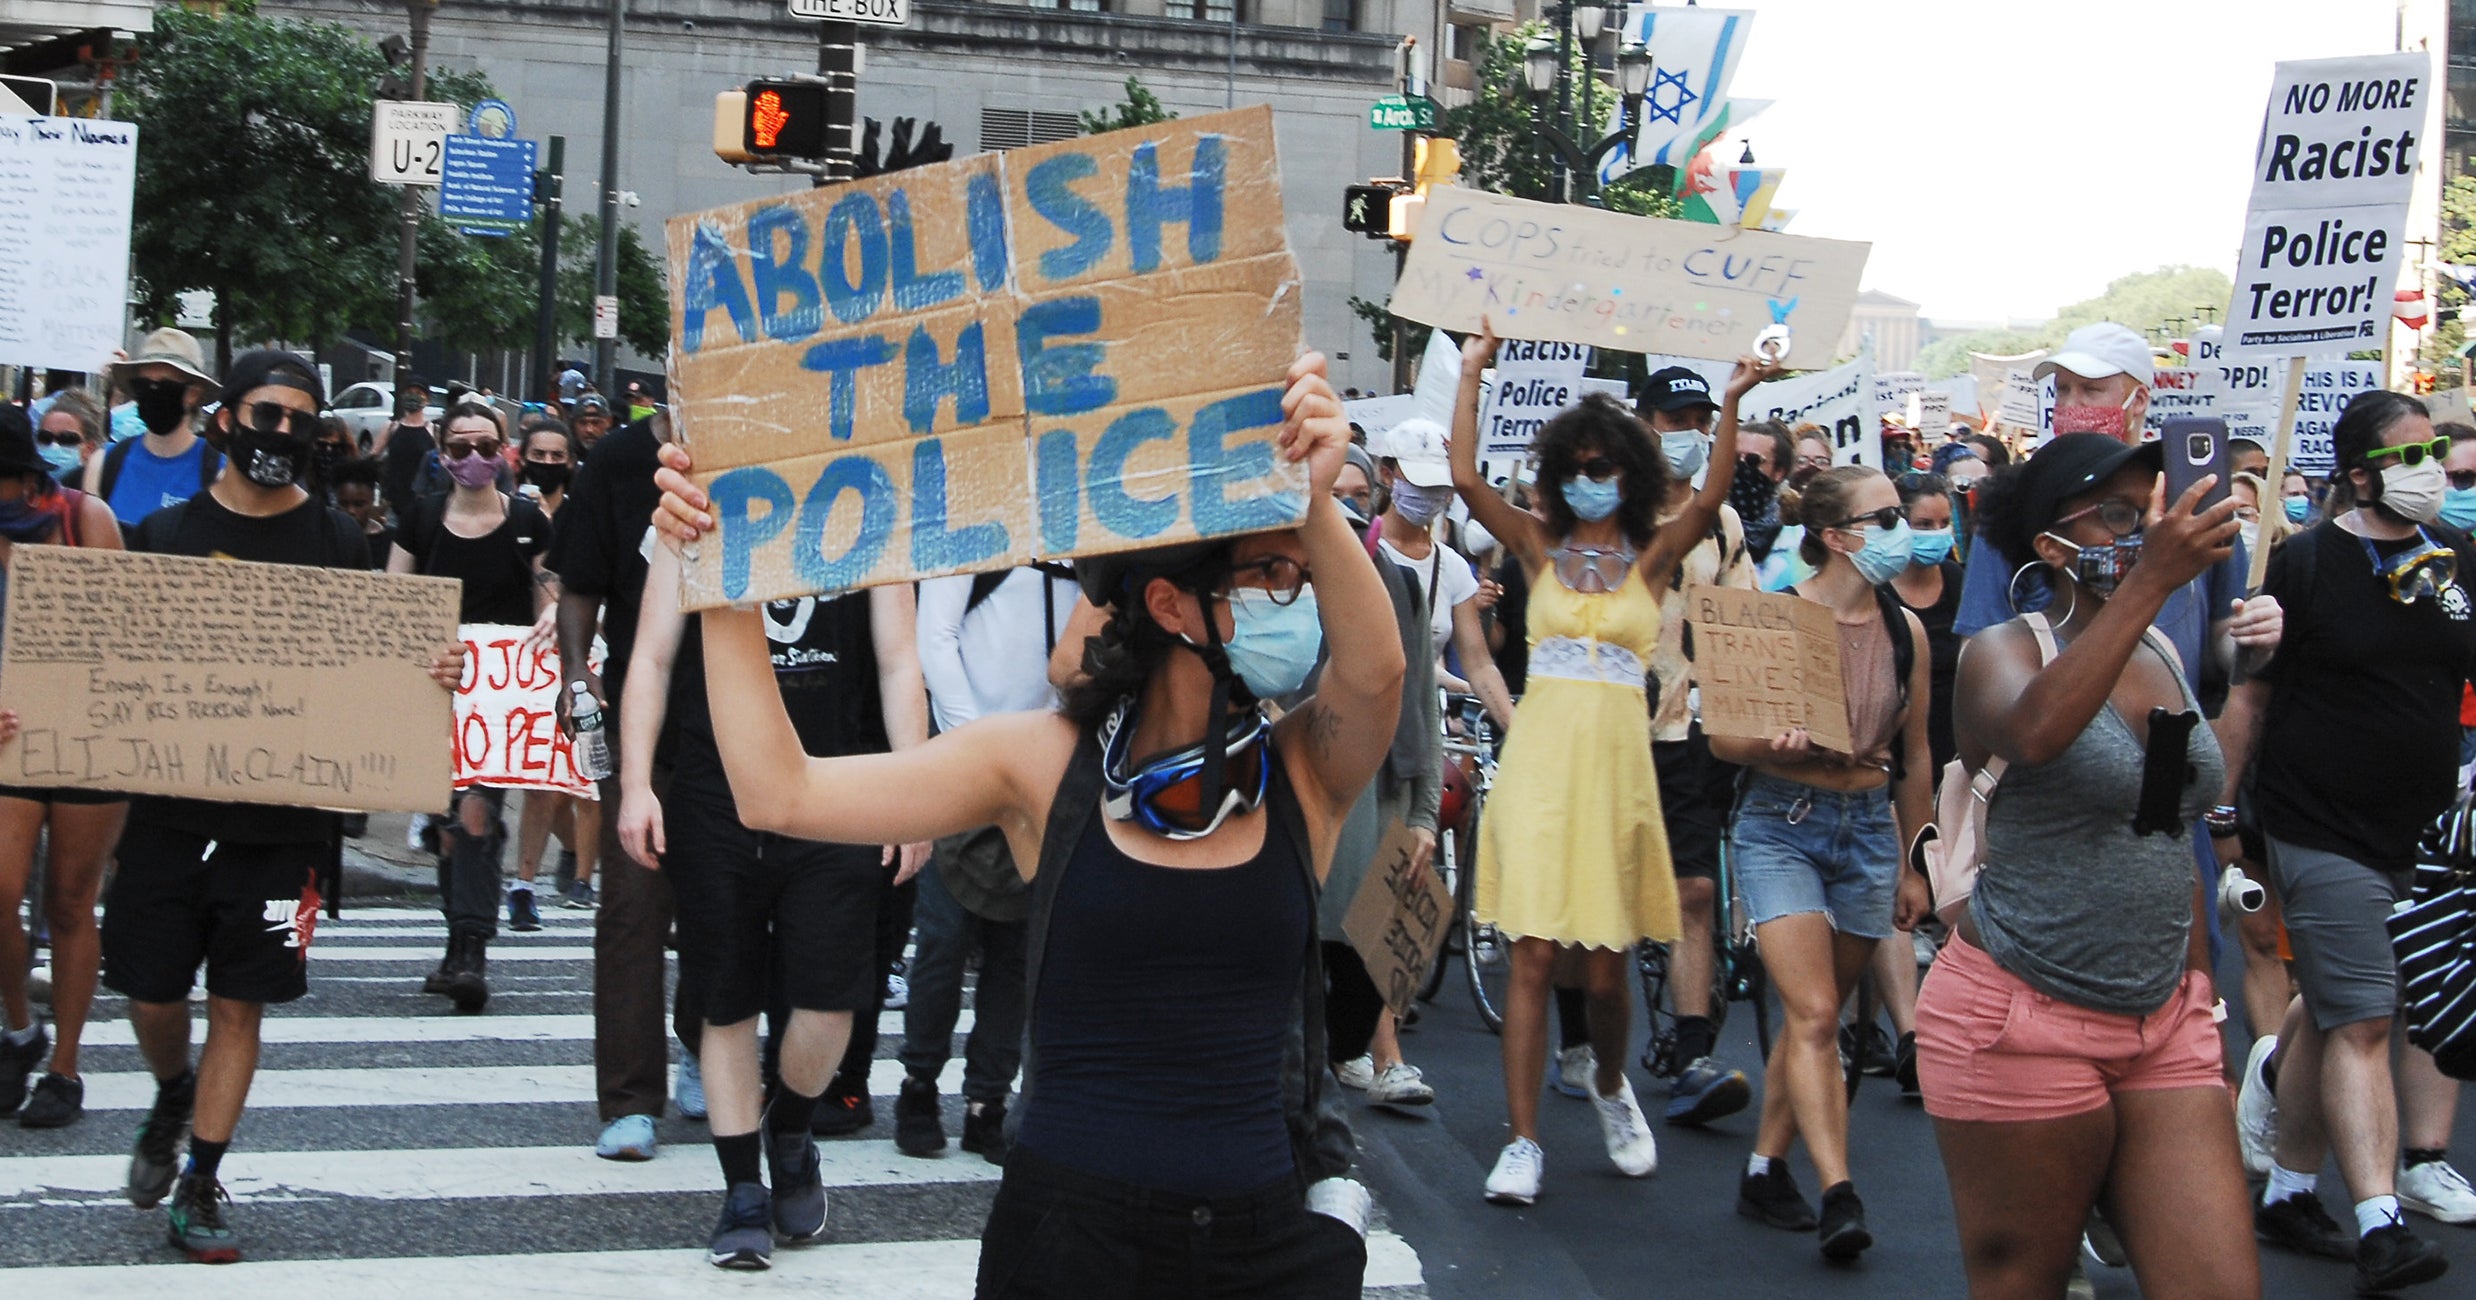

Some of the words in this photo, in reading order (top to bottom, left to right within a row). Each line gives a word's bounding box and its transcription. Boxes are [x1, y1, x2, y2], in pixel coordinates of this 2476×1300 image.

[2284, 83, 2330, 115] NO
[2337, 78, 2418, 113] MORE
[388, 121, 446, 131] LOCATION
[390, 109, 443, 119] PARKWAY
[2265, 125, 2415, 182] Racist
[683, 131, 1228, 353] ABOLISH
[1440, 206, 1562, 259] COPS
[1567, 241, 1629, 270] tried
[1641, 244, 1672, 274] to
[1683, 247, 1814, 294] CUFF
[2260, 219, 2388, 268] Police
[1483, 273, 1748, 336] Kindergartener
[2250, 276, 2378, 319] Terror!
[2201, 342, 2221, 360] De
[799, 297, 1118, 440] THE
[2304, 372, 2333, 387] HIS
[2341, 371, 2357, 387] IS
[2363, 371, 2376, 387] A
[1499, 379, 1568, 406] Police
[2296, 393, 2351, 412] REVO
[1492, 415, 1546, 436] Terro
[2301, 439, 2335, 454] RAC
[706, 388, 1300, 600] POLICE
[1701, 598, 1794, 630] BLACK
[1705, 631, 1796, 662] TRANS
[459, 640, 478, 695] O
[488, 640, 562, 693] JUS
[1710, 663, 1801, 692] LIVES
[89, 667, 154, 700] Enough
[162, 674, 193, 694] Is
[205, 673, 272, 700] Enough!
[87, 701, 133, 728] SAY
[1711, 696, 1814, 725] MATTER
